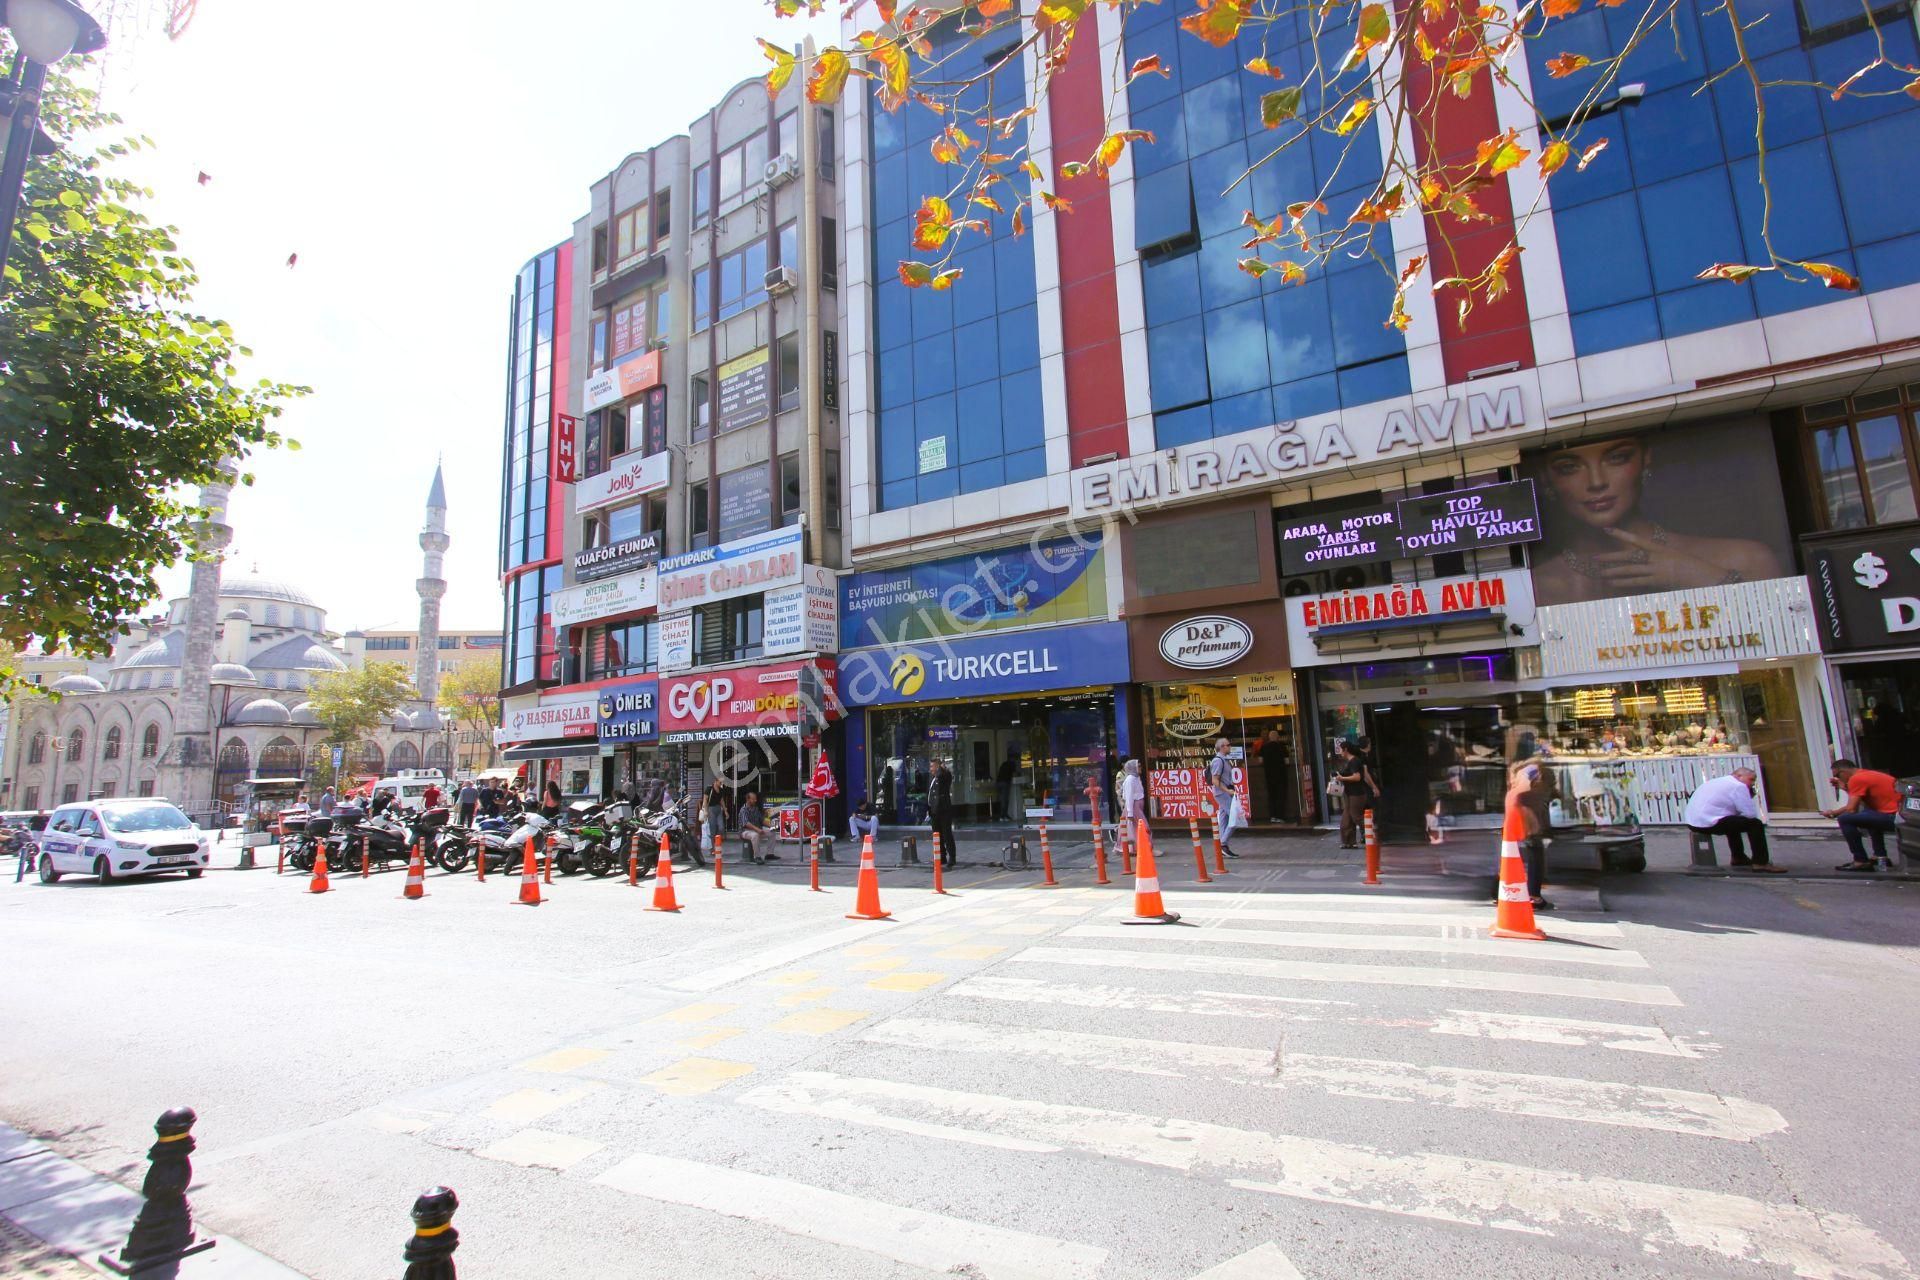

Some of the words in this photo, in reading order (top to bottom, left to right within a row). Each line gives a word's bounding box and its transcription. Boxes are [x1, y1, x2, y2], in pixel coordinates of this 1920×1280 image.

[560, 418, 572, 477] THY
[1083, 420, 1356, 509] EMİRAĞA
[1377, 386, 1526, 453] AVM
[607, 474, 634, 494] Jolly
[1447, 496, 1482, 513] TOP
[1284, 523, 1327, 540] ARABA
[1342, 512, 1393, 530] MOTOR
[1432, 508, 1503, 532] HAVUZU
[1407, 530, 1456, 549] OYUN
[1476, 519, 1534, 539] PARKI
[575, 546, 616, 568] KUAFÖR
[619, 535, 656, 556] FUNDA
[659, 548, 716, 571] DUYUPARK
[1305, 541, 1376, 562] OYUNLARI
[586, 581, 618, 597] DİYETİSYEN
[660, 573, 706, 608] İŞİTME
[710, 552, 796, 592] CİHAZLARI
[849, 587, 861, 598] EV
[863, 577, 912, 596] İNTERNETİ
[807, 585, 835, 598] DUYUPARK
[849, 594, 894, 611] BAŞVURU
[895, 587, 939, 604] NOKTASI
[809, 598, 833, 610] İŞİTME
[1302, 584, 1430, 628] EMİRAĞA
[1442, 579, 1506, 613] AVM
[662, 619, 689, 631] İŞİTME
[1631, 602, 1720, 637] ELİF
[662, 630, 689, 641] CİHAZI
[1187, 623, 1225, 641] D&P
[1177, 640, 1241, 658] perfumum
[1597, 632, 1762, 660] KUYUMCULUK
[933, 648, 1058, 682] TURKCELL
[616, 692, 652, 712] ÖMER
[669, 678, 734, 724] GOP
[731, 699, 755, 714] MEYDAN
[1181, 710, 1206, 721] D&P
[601, 719, 651, 738] İLETİŞİM
[666, 730, 694, 743] LEZZETİN
[695, 730, 707, 741] TEK
[708, 728, 731, 740] ADRESİ
[733, 729, 747, 738] GOP
[747, 727, 776, 738] MEYDAN
[1166, 748, 1183, 757] BAY
[1194, 747, 1217, 756] BAYA
[1154, 769, 1191, 786] %50
[1163, 802, 1187, 817] 270
